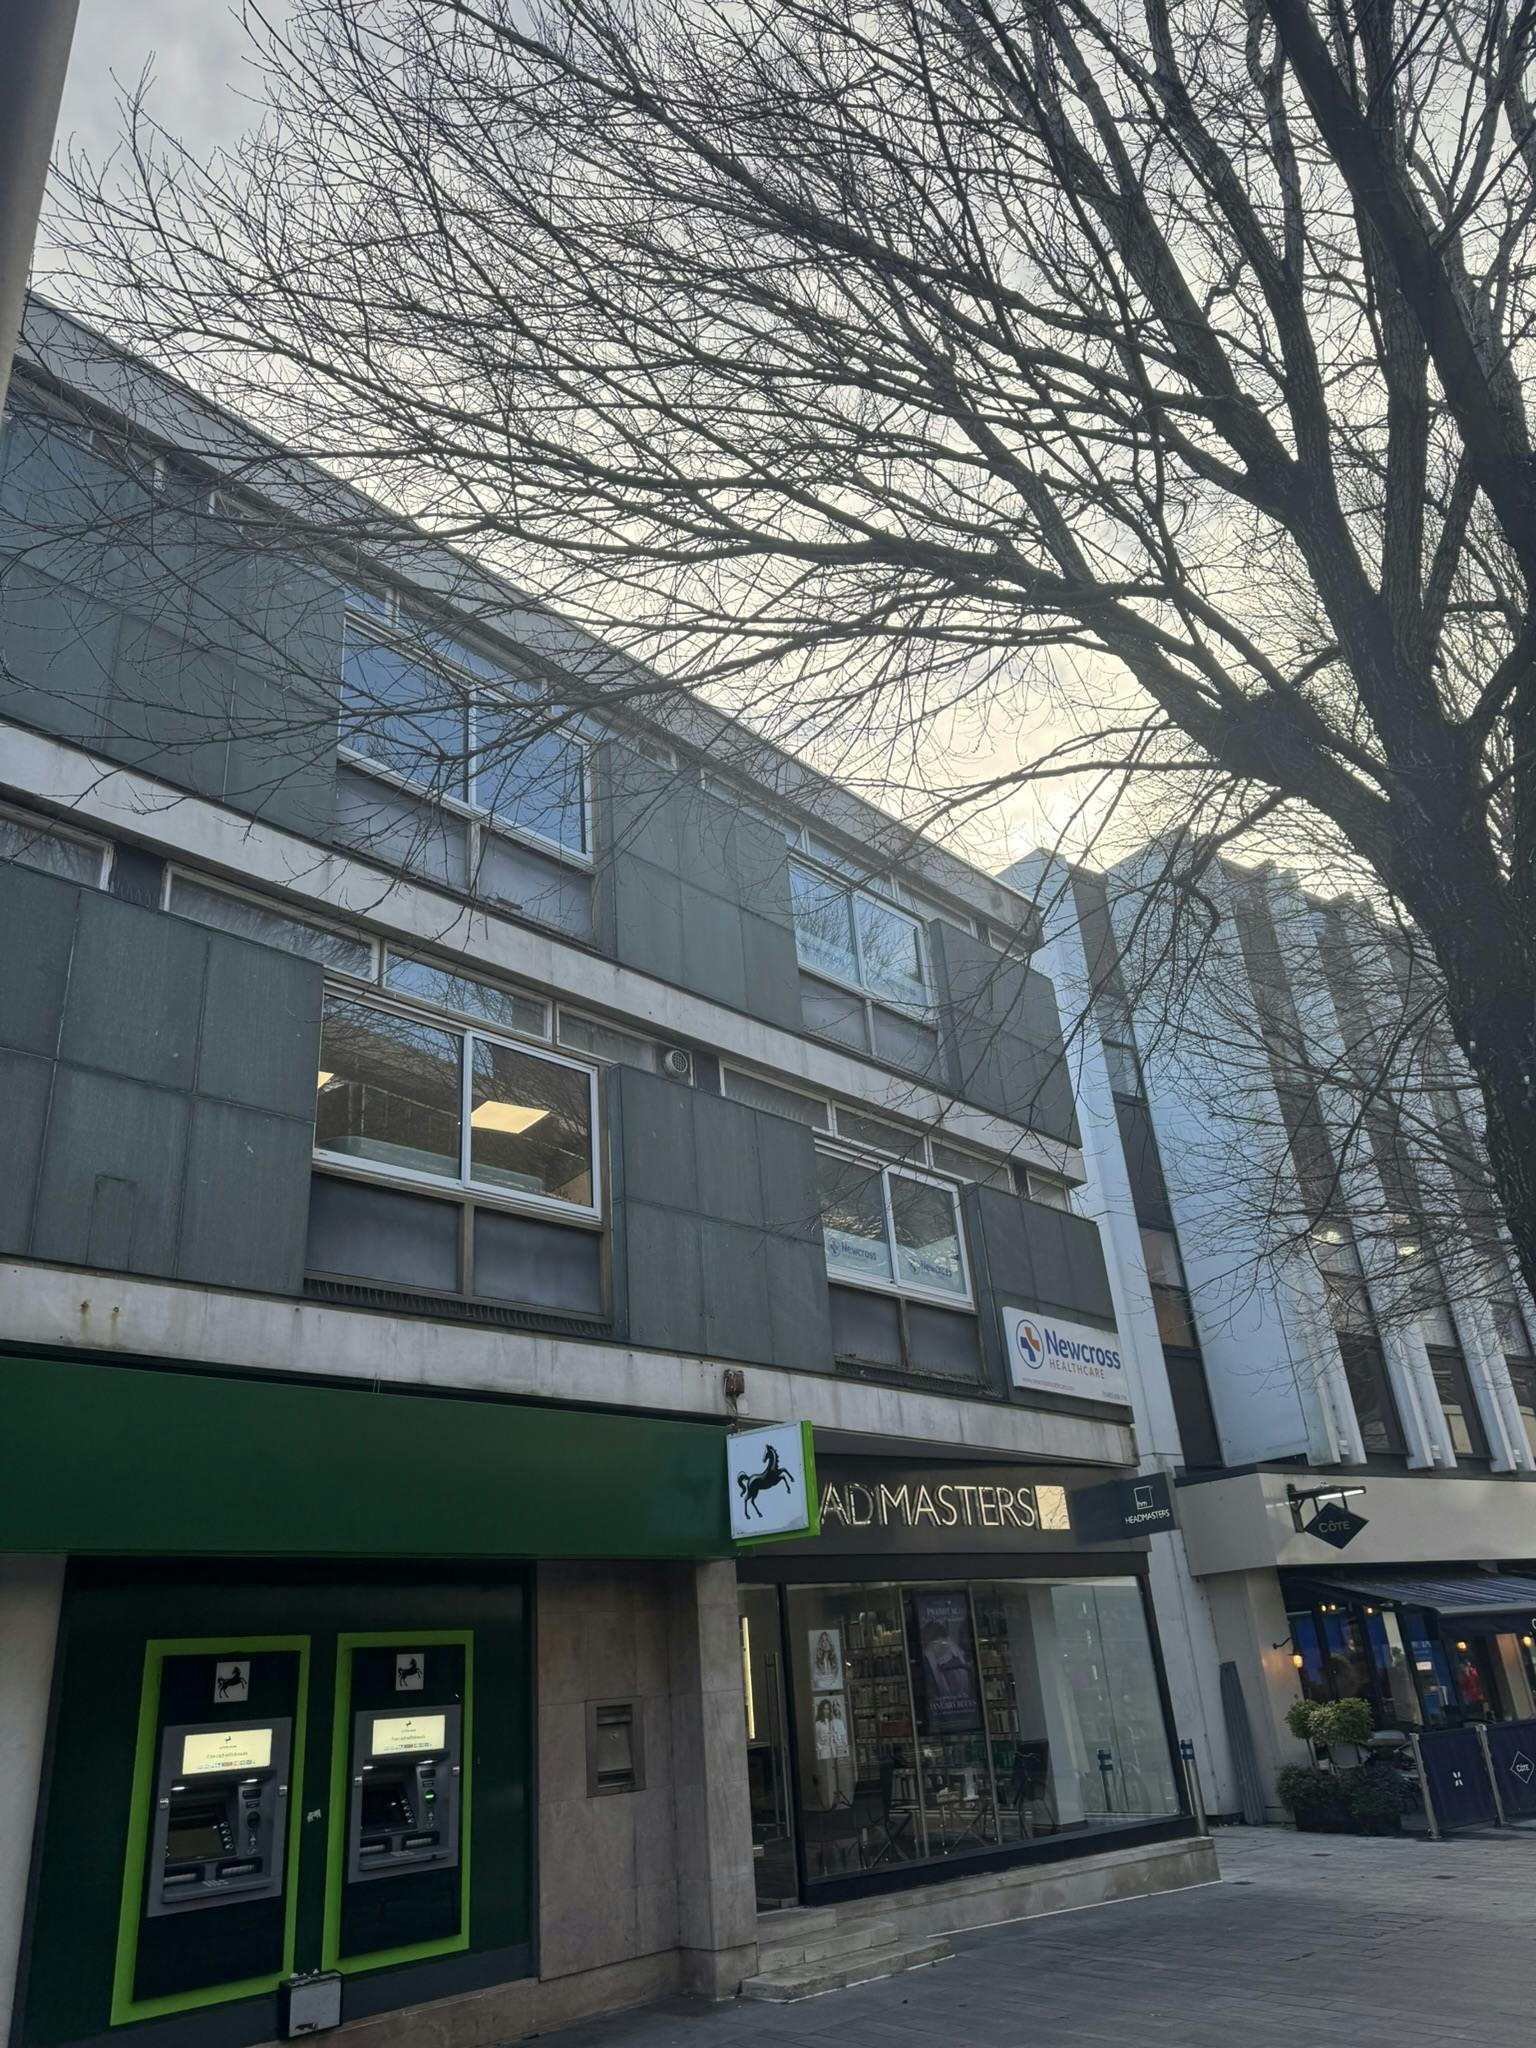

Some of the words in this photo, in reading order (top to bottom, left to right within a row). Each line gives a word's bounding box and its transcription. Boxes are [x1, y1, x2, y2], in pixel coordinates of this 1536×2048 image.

[840, 1241, 877, 1261] Newcross
[1044, 1328, 1122, 1370] Newcross
[1048, 1358, 1105, 1380] HEALTHCARE
[1125, 1508, 1171, 1525] HEADMASTERS
